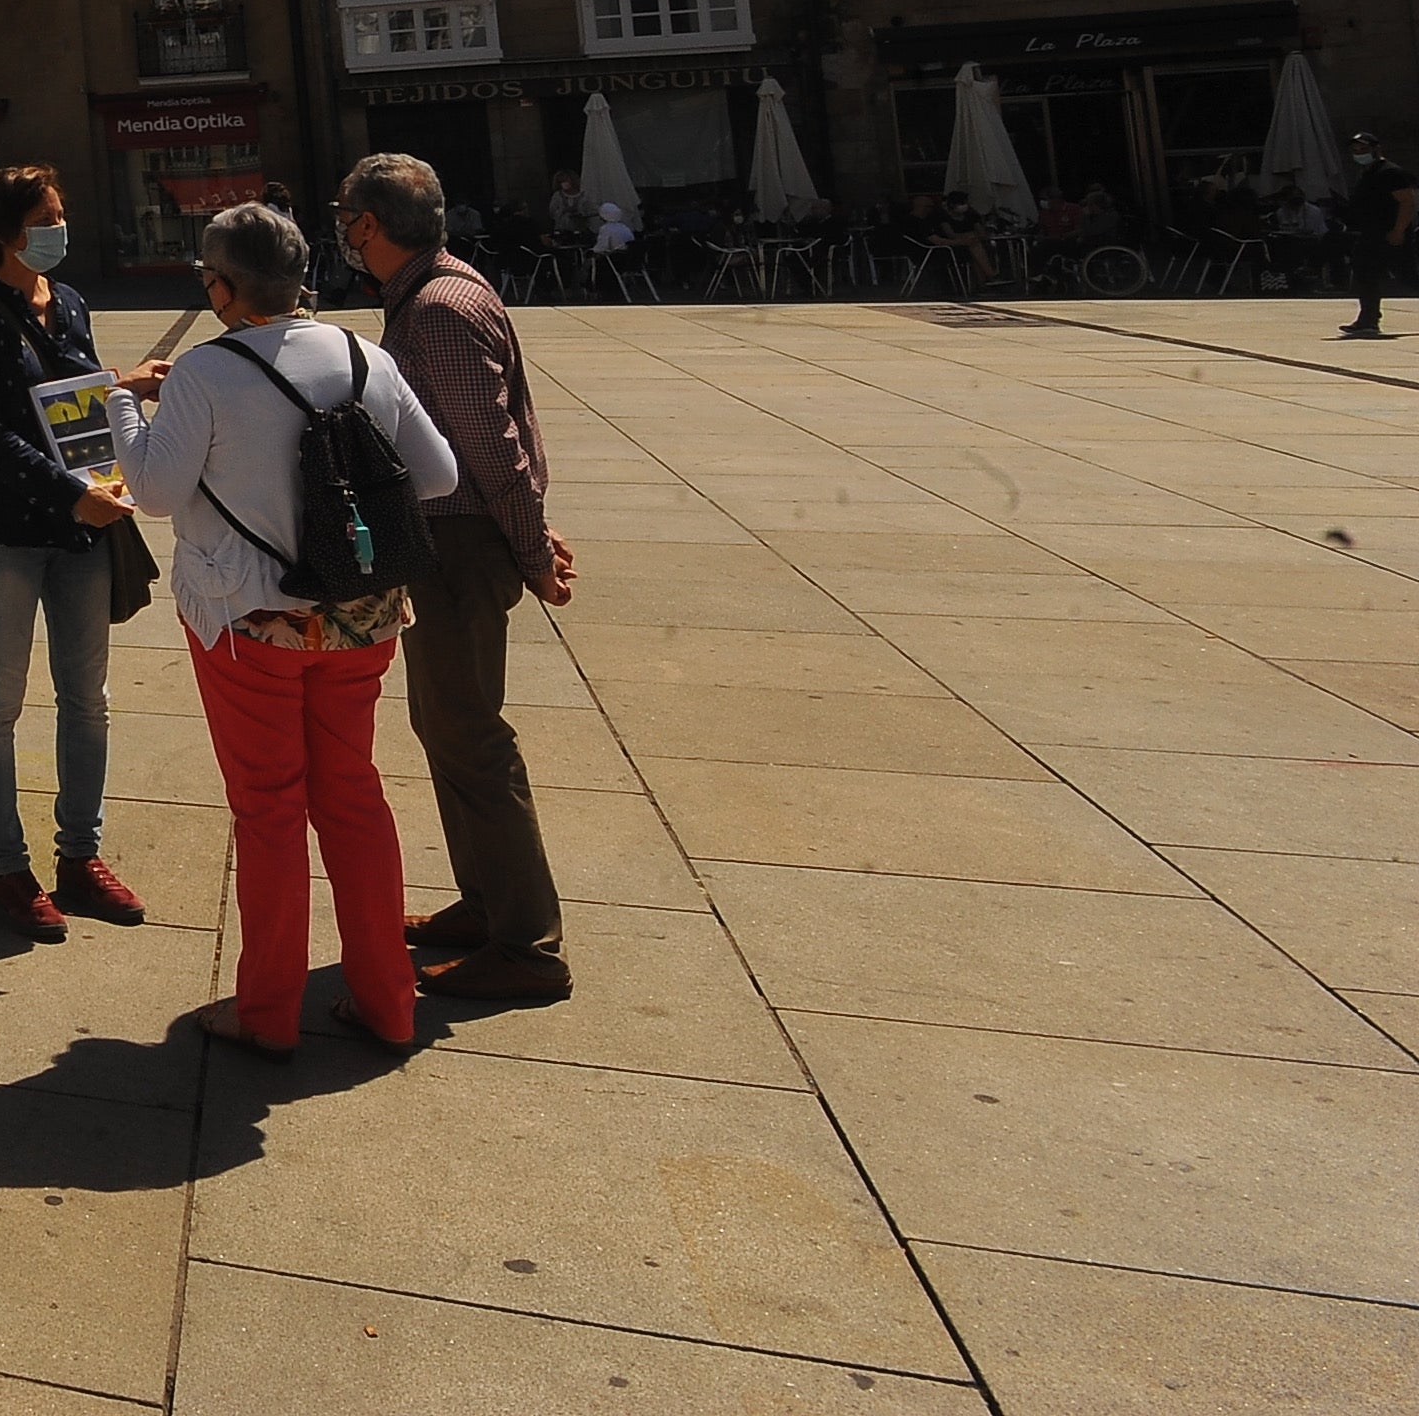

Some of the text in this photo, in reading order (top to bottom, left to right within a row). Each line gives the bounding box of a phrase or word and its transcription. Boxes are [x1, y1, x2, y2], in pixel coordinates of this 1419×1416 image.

[1026, 32, 1143, 52] La Plaza
[361, 67, 771, 105] TEJIDOS JUNGUITU
[146, 97, 211, 108] Mendia Optika
[117, 113, 246, 133] Mendia Optika
